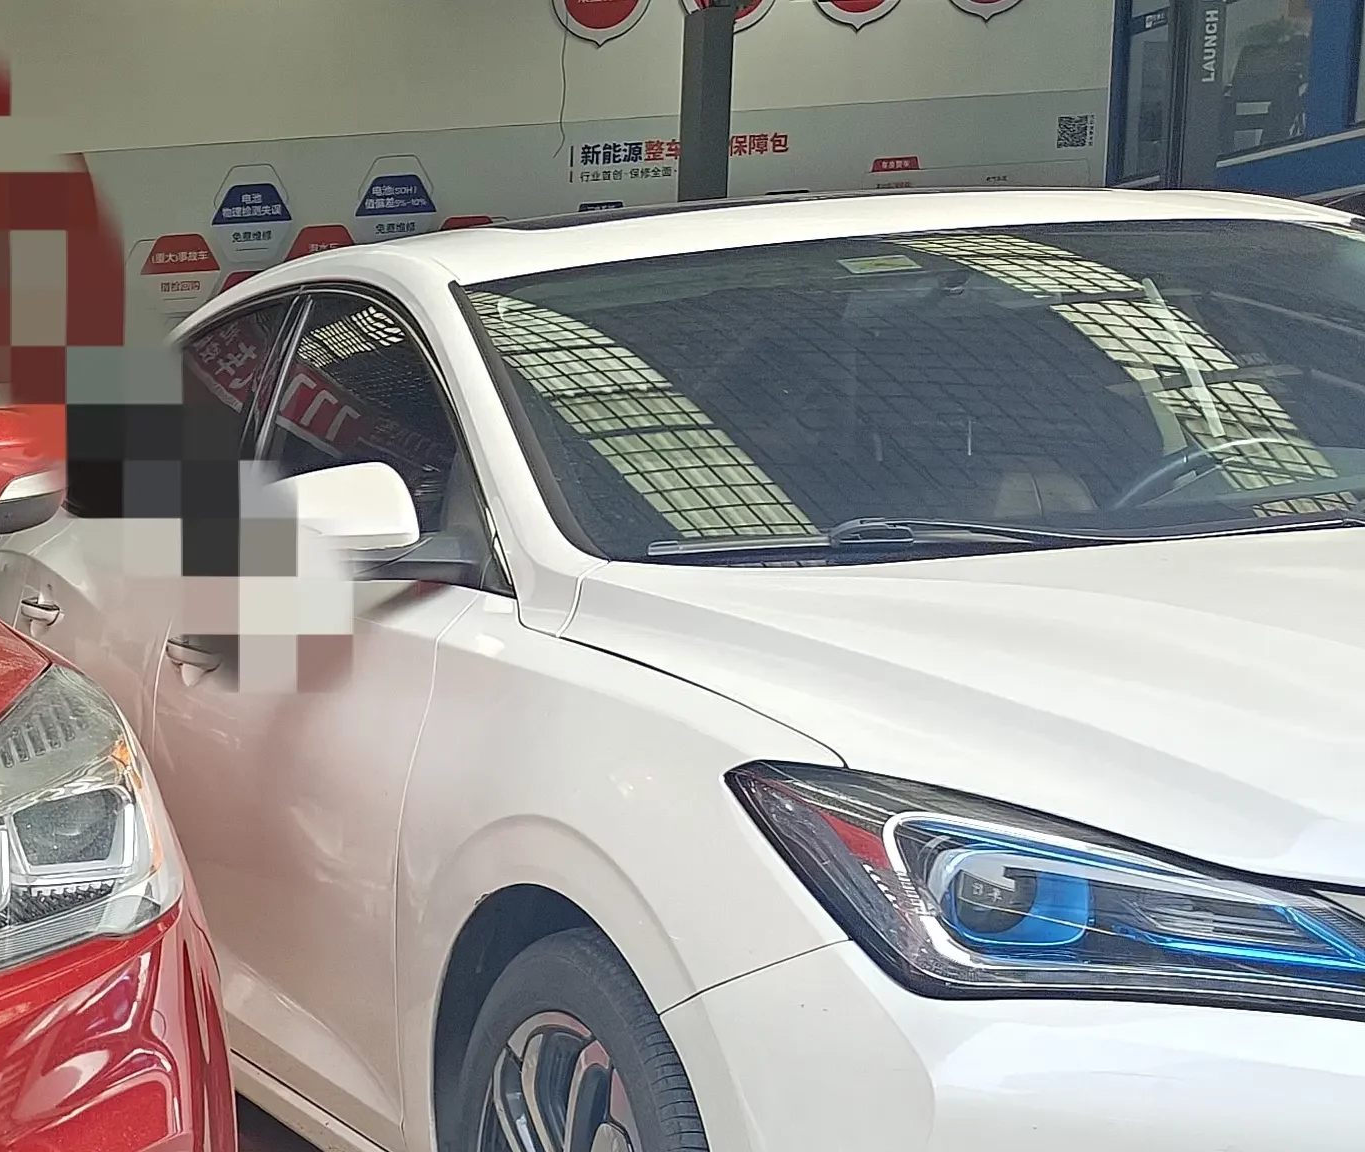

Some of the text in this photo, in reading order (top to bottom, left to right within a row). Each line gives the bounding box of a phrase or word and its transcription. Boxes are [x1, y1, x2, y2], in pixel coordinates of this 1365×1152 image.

[1202, 10, 1219, 83] LAUNCH
[580, 132, 789, 166] 新能源整车 保障包
